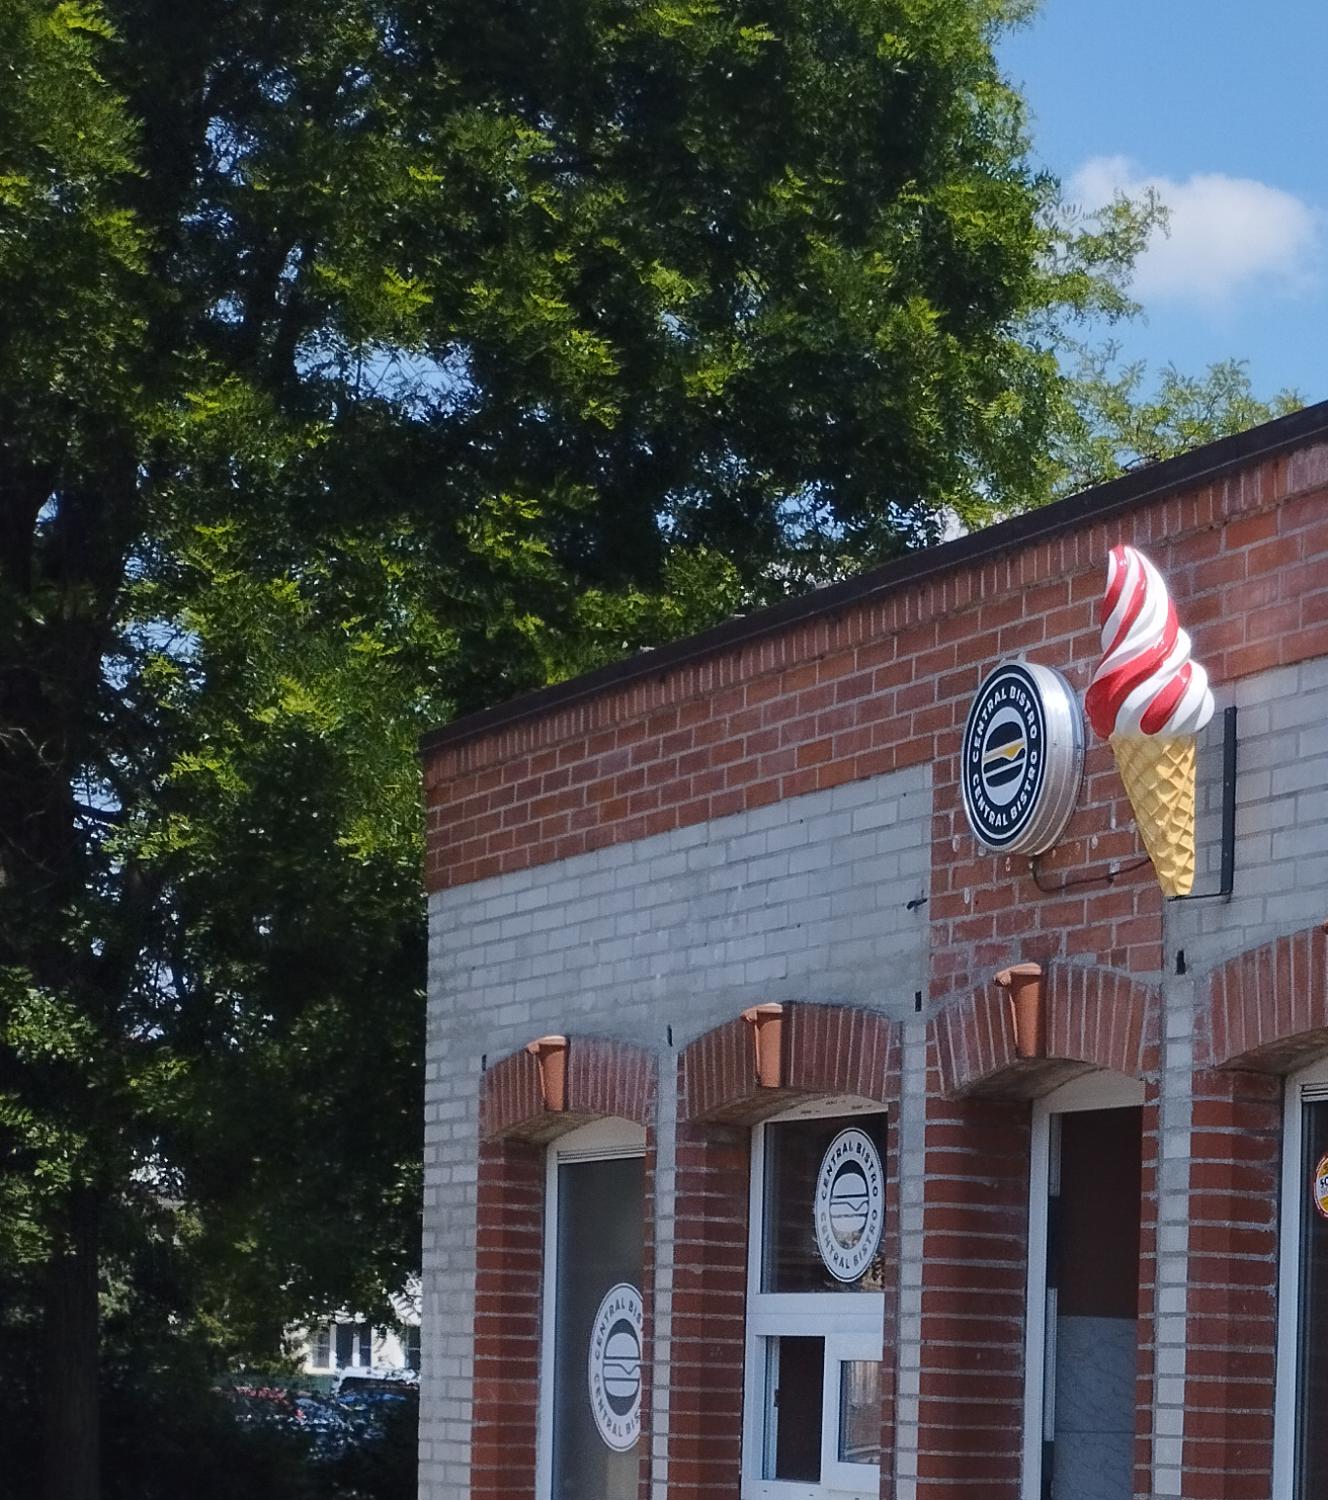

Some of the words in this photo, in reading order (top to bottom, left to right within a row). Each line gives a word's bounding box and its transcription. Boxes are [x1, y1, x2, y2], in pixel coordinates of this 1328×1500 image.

[972, 687, 1007, 763] CENTRAL
[1009, 686, 1037, 739] BISTRO
[972, 773, 1008, 826] CENTRAL
[1010, 751, 1038, 820] BISTRO
[821, 1140, 854, 1200] CENTRAL
[856, 1142, 879, 1198] BISTRO
[595, 1297, 625, 1360] CENTRAL
[629, 1300, 642, 1325] BIS
